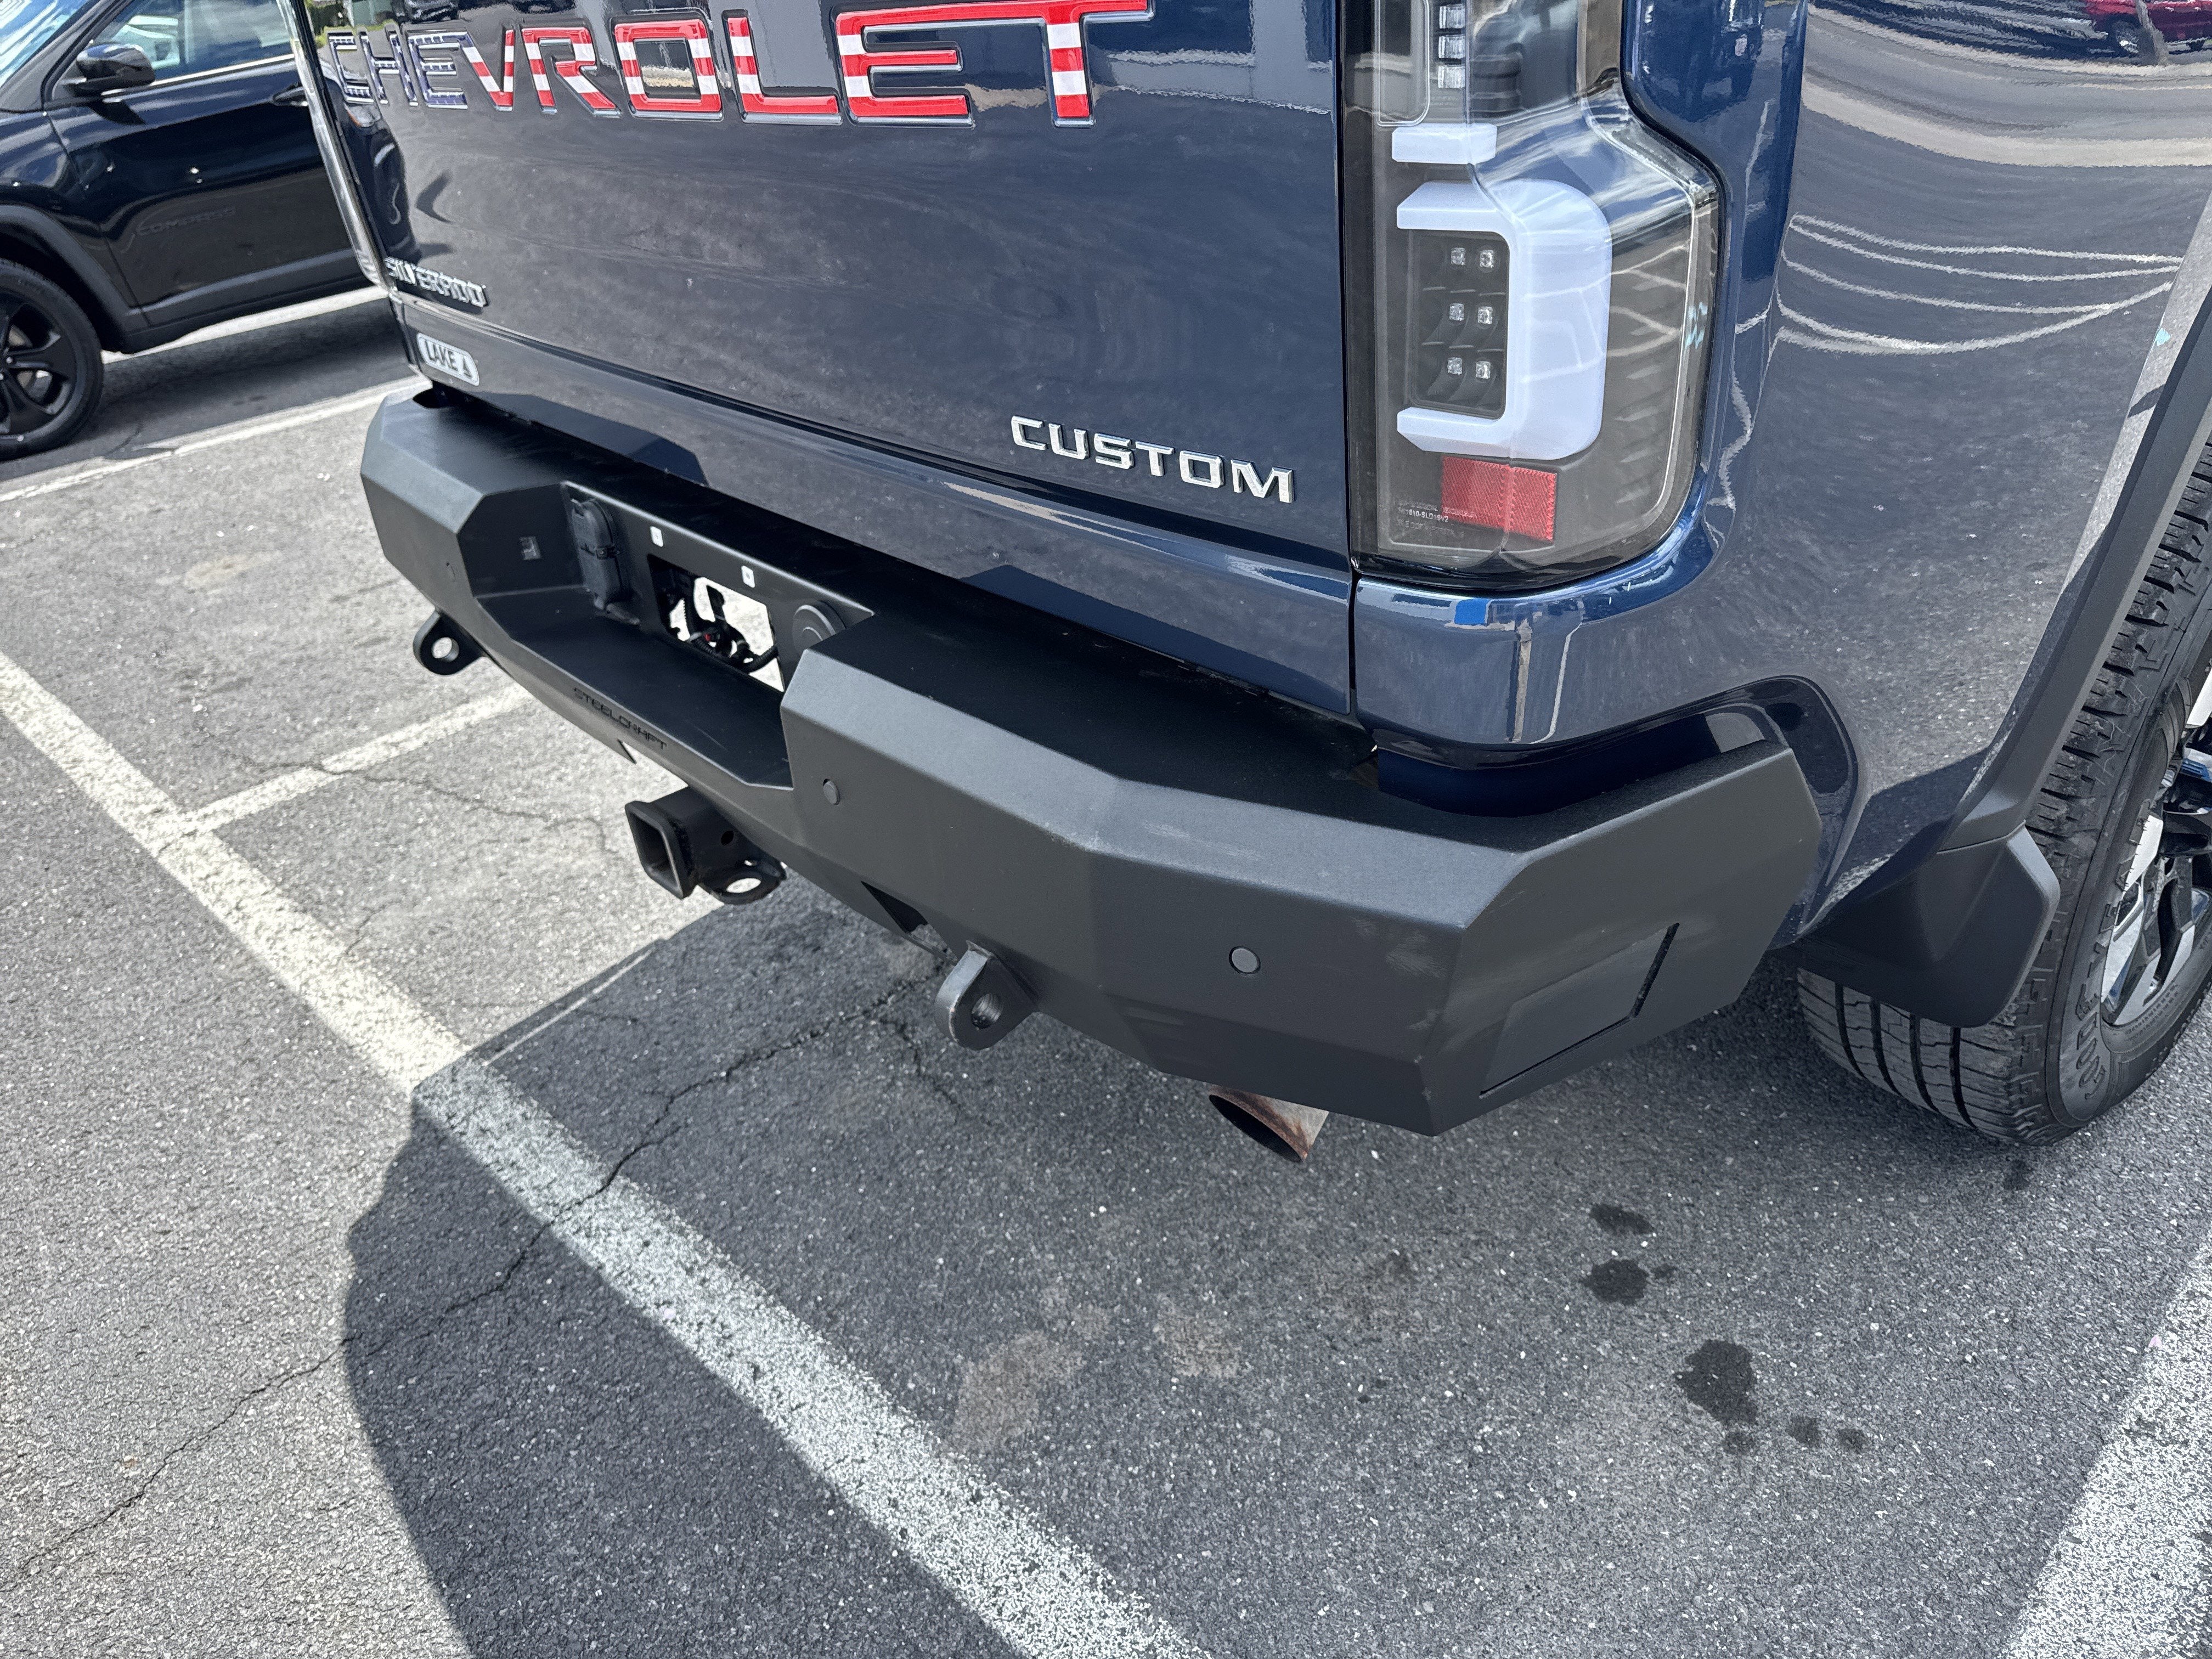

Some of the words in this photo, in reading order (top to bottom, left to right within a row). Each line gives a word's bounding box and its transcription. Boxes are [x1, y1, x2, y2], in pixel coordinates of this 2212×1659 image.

[328, 0, 1155, 127] CHEVROLET
[383, 256, 488, 308] SILVERADO
[1011, 415, 1295, 503] CUSTOM
